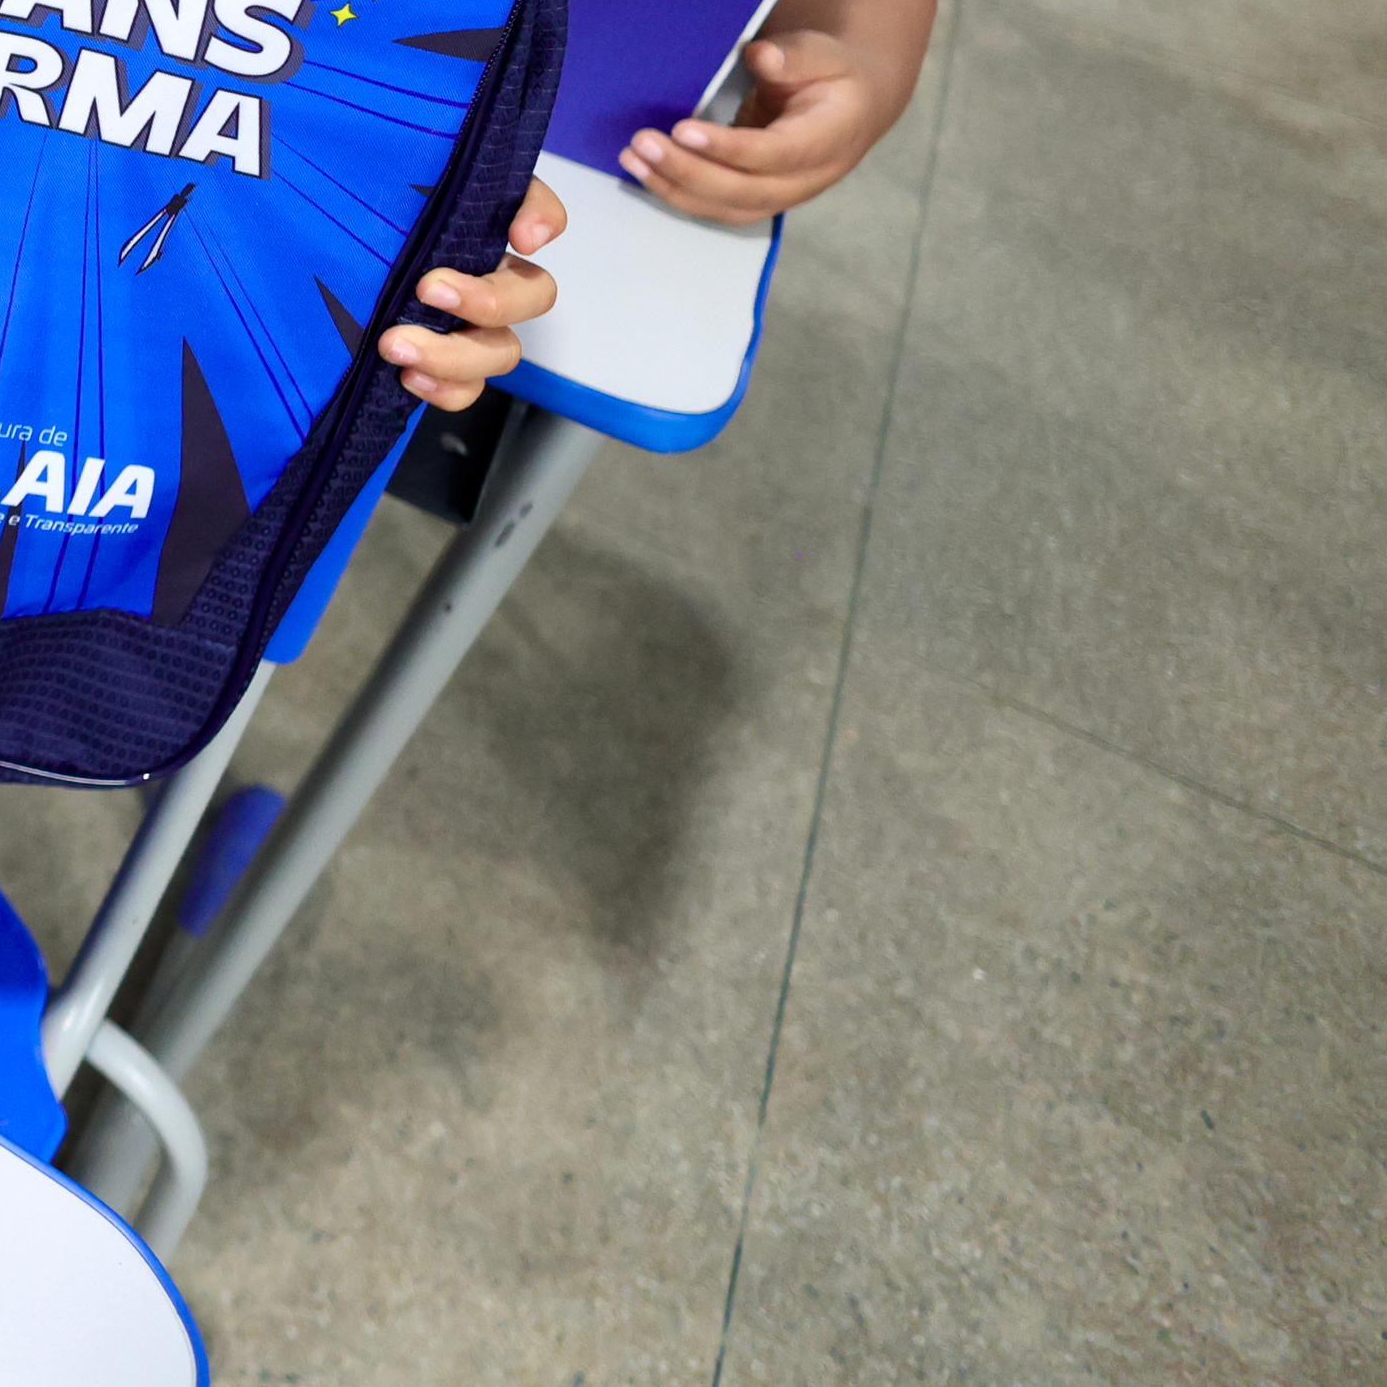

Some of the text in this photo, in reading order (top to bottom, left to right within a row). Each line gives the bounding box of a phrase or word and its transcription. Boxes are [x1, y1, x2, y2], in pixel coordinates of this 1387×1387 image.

[39, 425, 68, 446] de
[8, 514, 20, 527] e
[25, 514, 139, 536] Transparente
